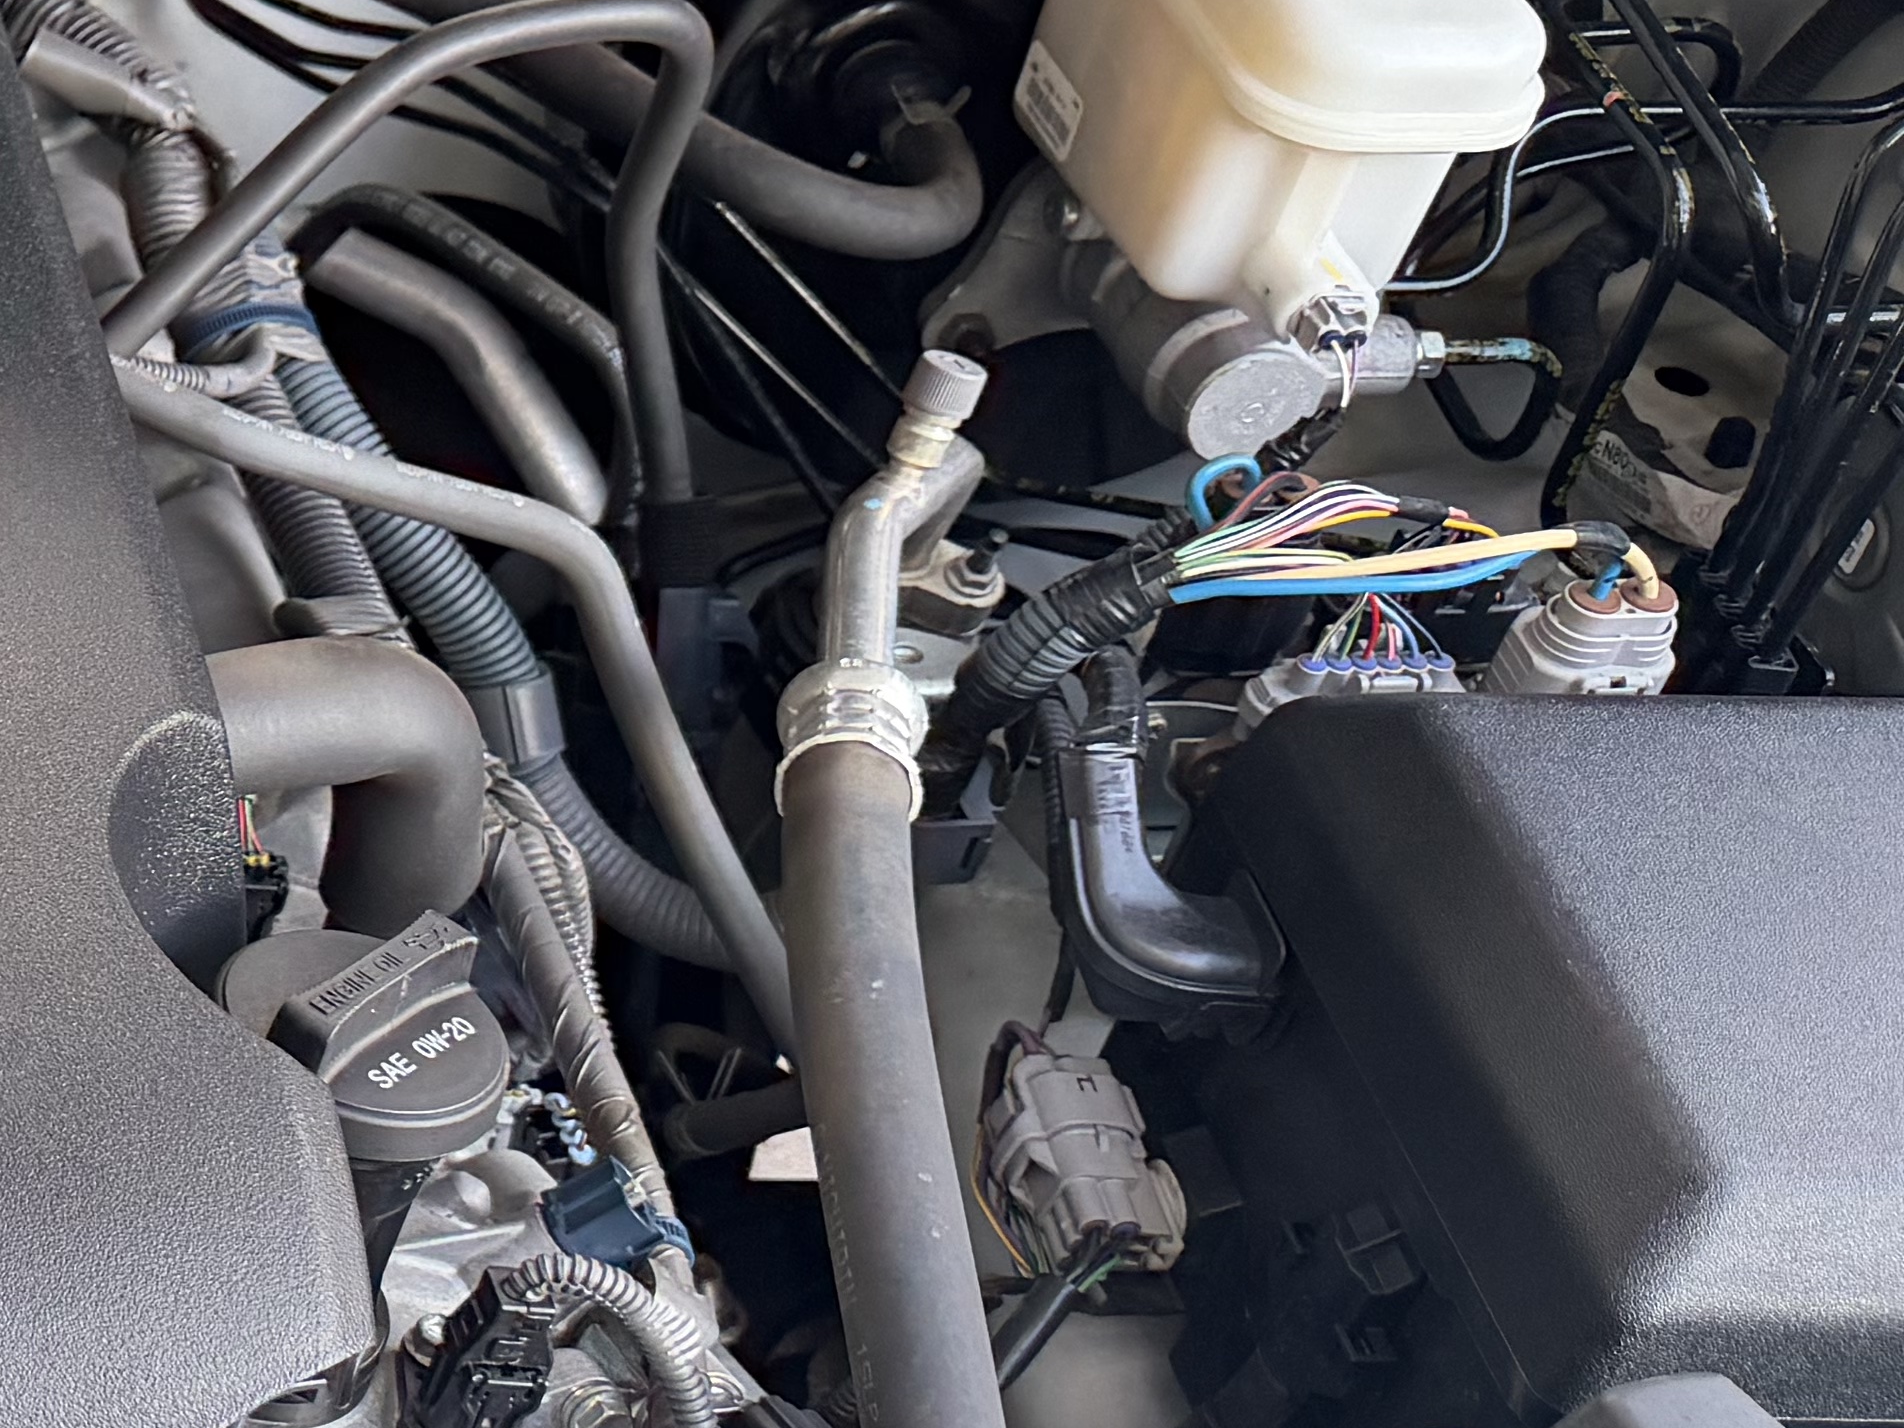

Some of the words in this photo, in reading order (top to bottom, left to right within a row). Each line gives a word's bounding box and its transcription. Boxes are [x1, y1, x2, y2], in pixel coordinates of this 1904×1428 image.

[377, 950, 409, 977] OIL
[367, 1052, 419, 1090] SAE
[411, 1016, 477, 1060] 0W-20
